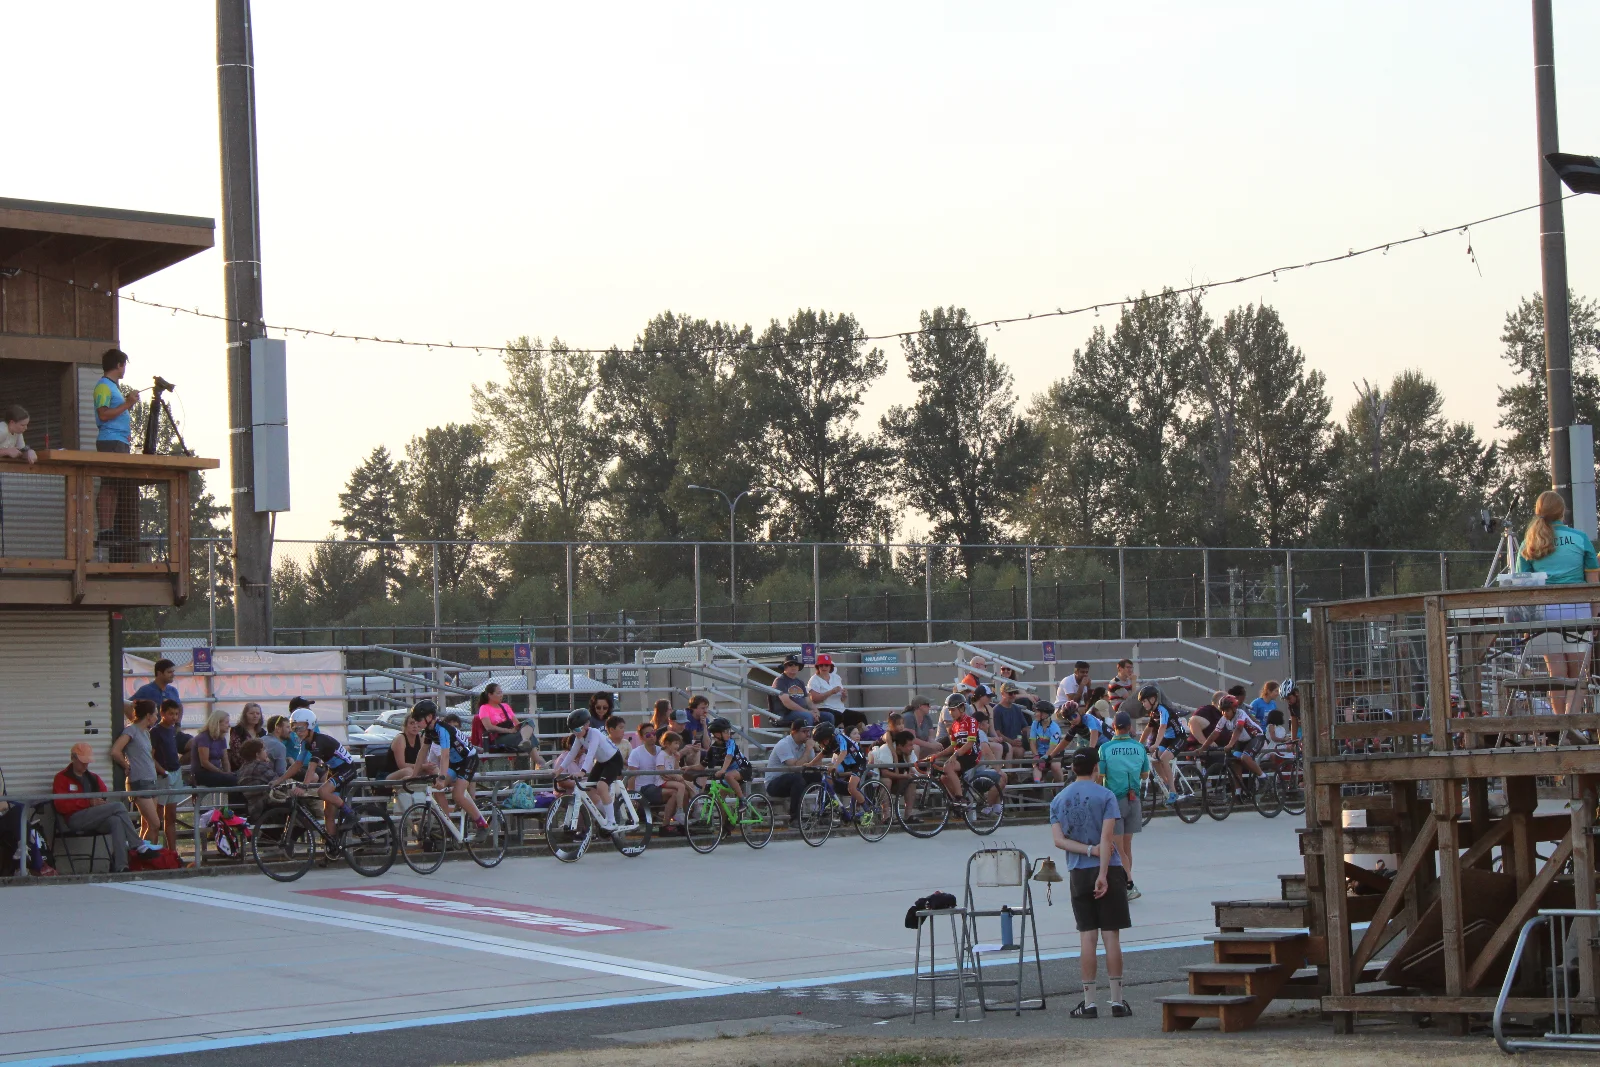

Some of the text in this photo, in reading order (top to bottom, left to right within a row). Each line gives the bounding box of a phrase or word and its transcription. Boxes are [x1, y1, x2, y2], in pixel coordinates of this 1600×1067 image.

[1553, 536, 1576, 547] CIAL
[1253, 649, 1268, 657] RENT
[1111, 747, 1140, 756] OFFICIAL
